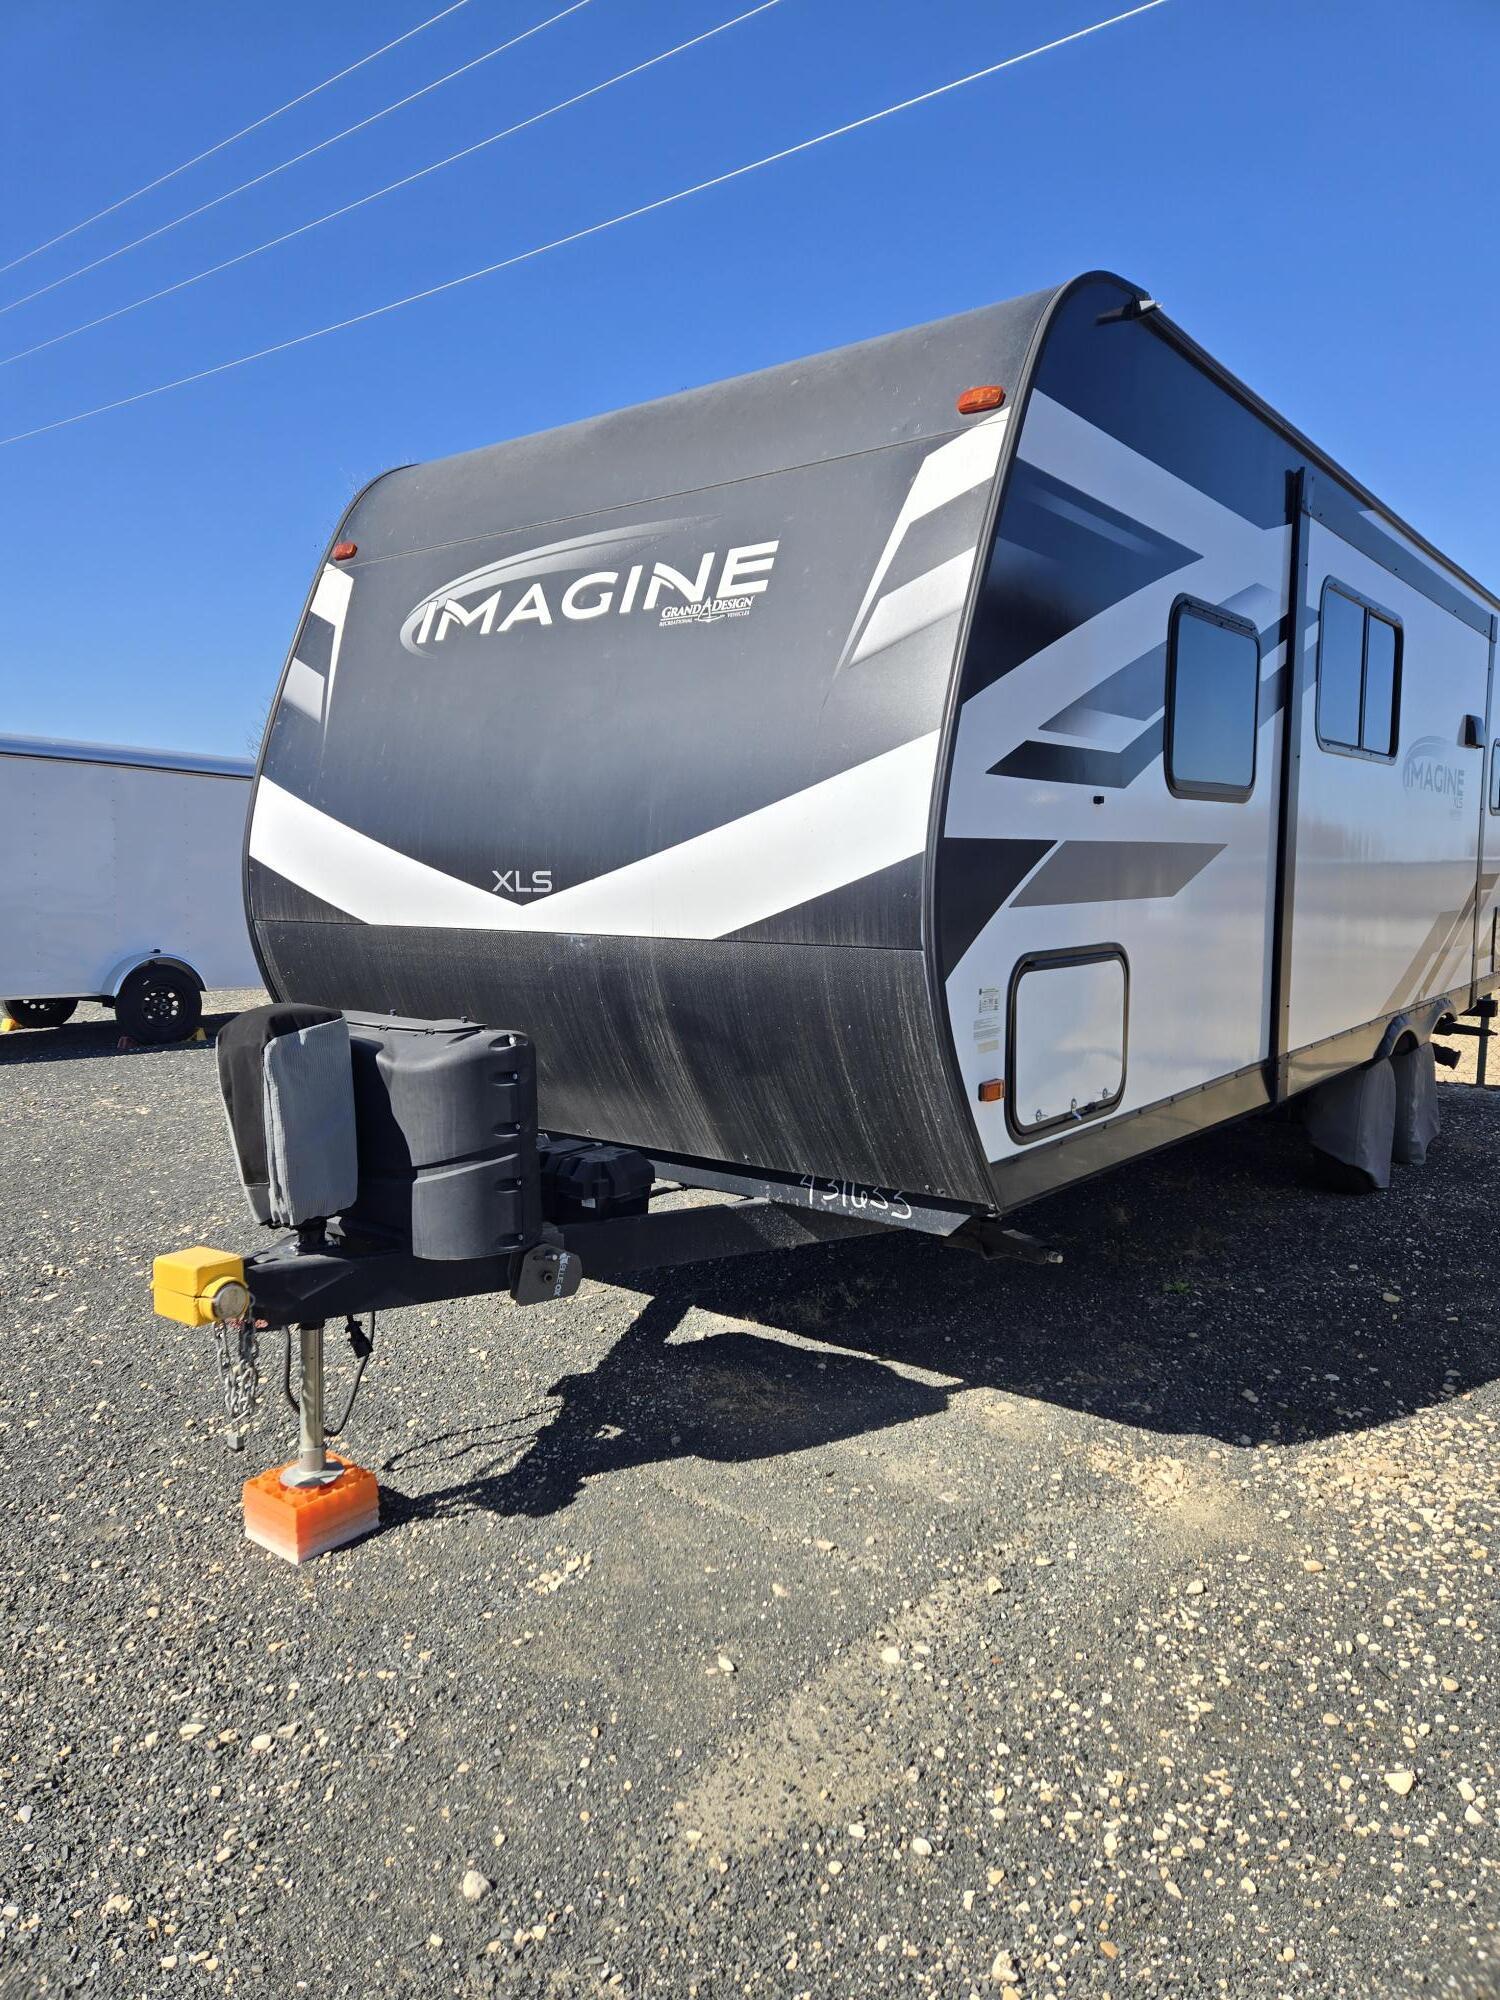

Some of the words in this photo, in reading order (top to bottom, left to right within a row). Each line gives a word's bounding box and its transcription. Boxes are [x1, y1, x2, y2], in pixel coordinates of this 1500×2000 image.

[416, 540, 780, 643] IMAGINE
[661, 603, 701, 619] GRAND
[711, 596, 754, 612] DESIGN
[1406, 759, 1464, 796] IMAGINE
[492, 871, 552, 892] XLS
